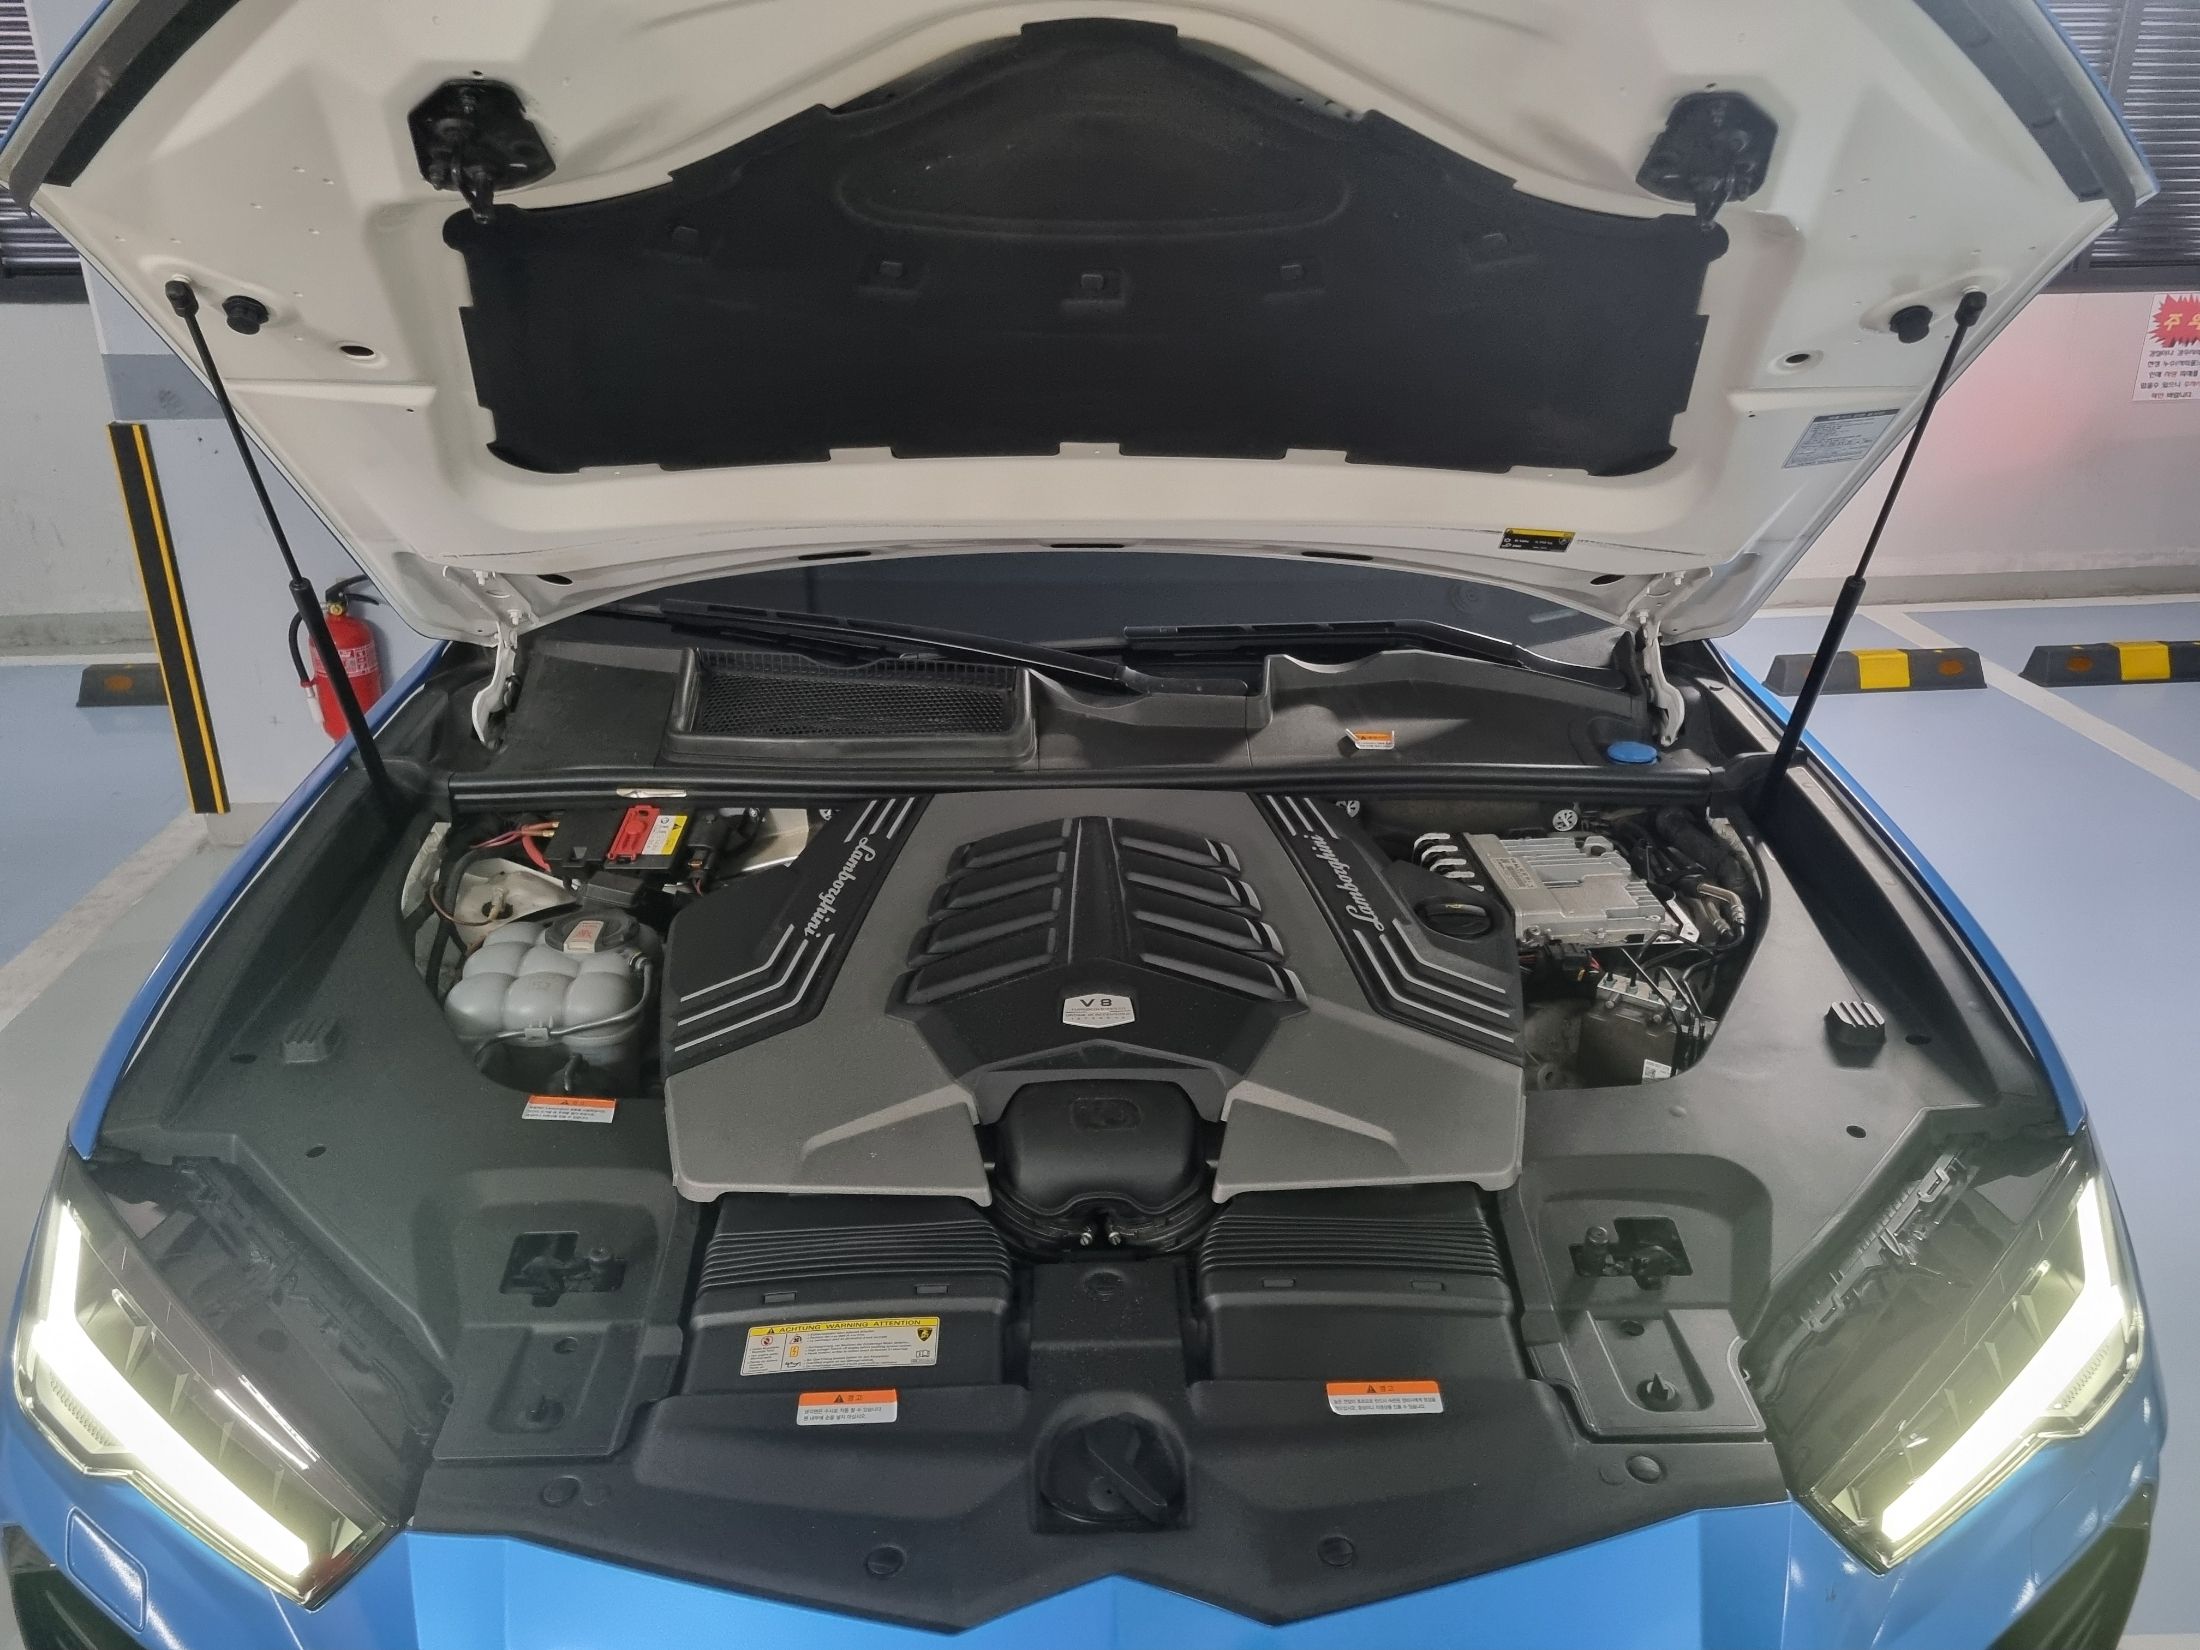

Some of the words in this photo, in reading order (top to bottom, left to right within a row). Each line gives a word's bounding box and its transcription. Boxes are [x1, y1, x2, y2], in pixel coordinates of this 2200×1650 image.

[804, 837, 876, 937] Lamborghini
[1304, 834, 1384, 931] Lamborghini
[779, 1325, 820, 1333] ACHTUNG
